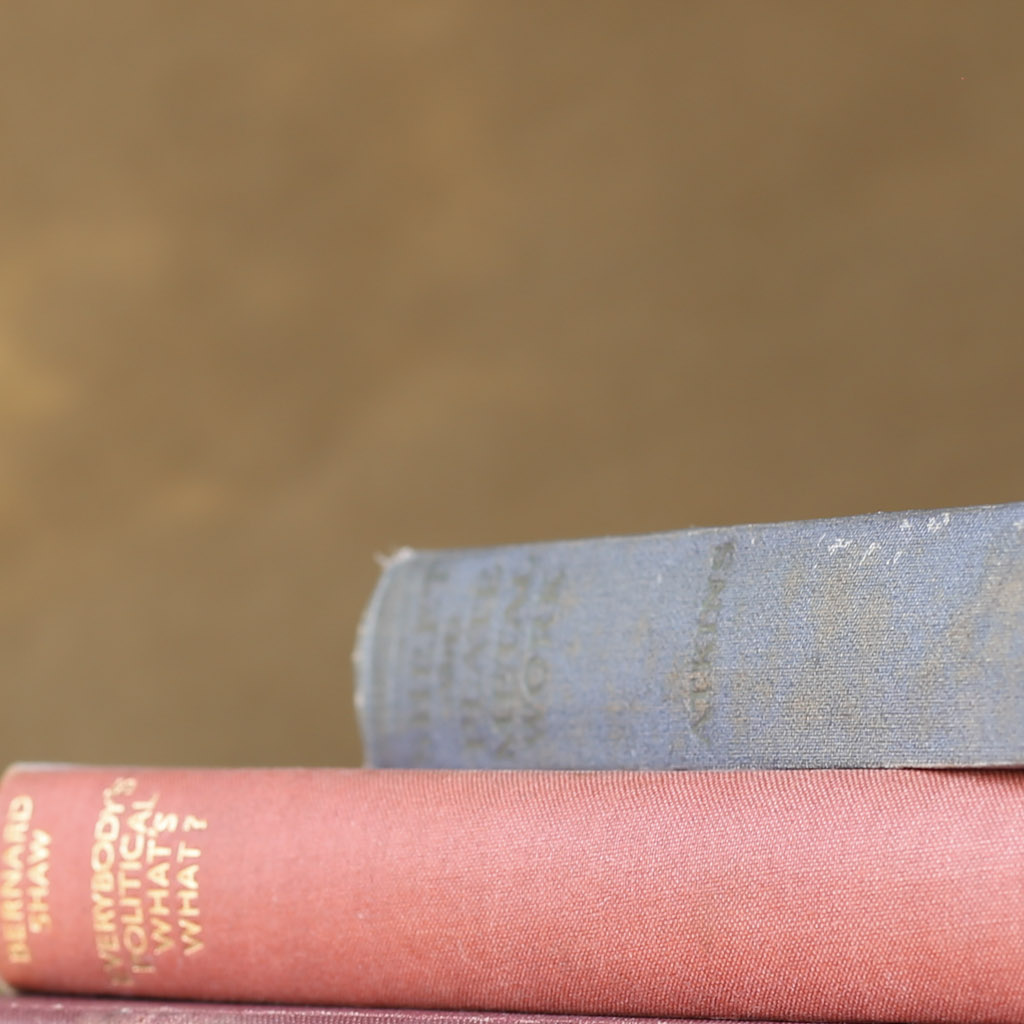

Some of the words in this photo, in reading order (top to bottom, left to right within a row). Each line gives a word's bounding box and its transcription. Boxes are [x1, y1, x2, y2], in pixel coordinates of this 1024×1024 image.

[0, 795, 33, 963] BERNARD
[27, 828, 53, 934] SHAW
[146, 811, 179, 956] WHAT'S
